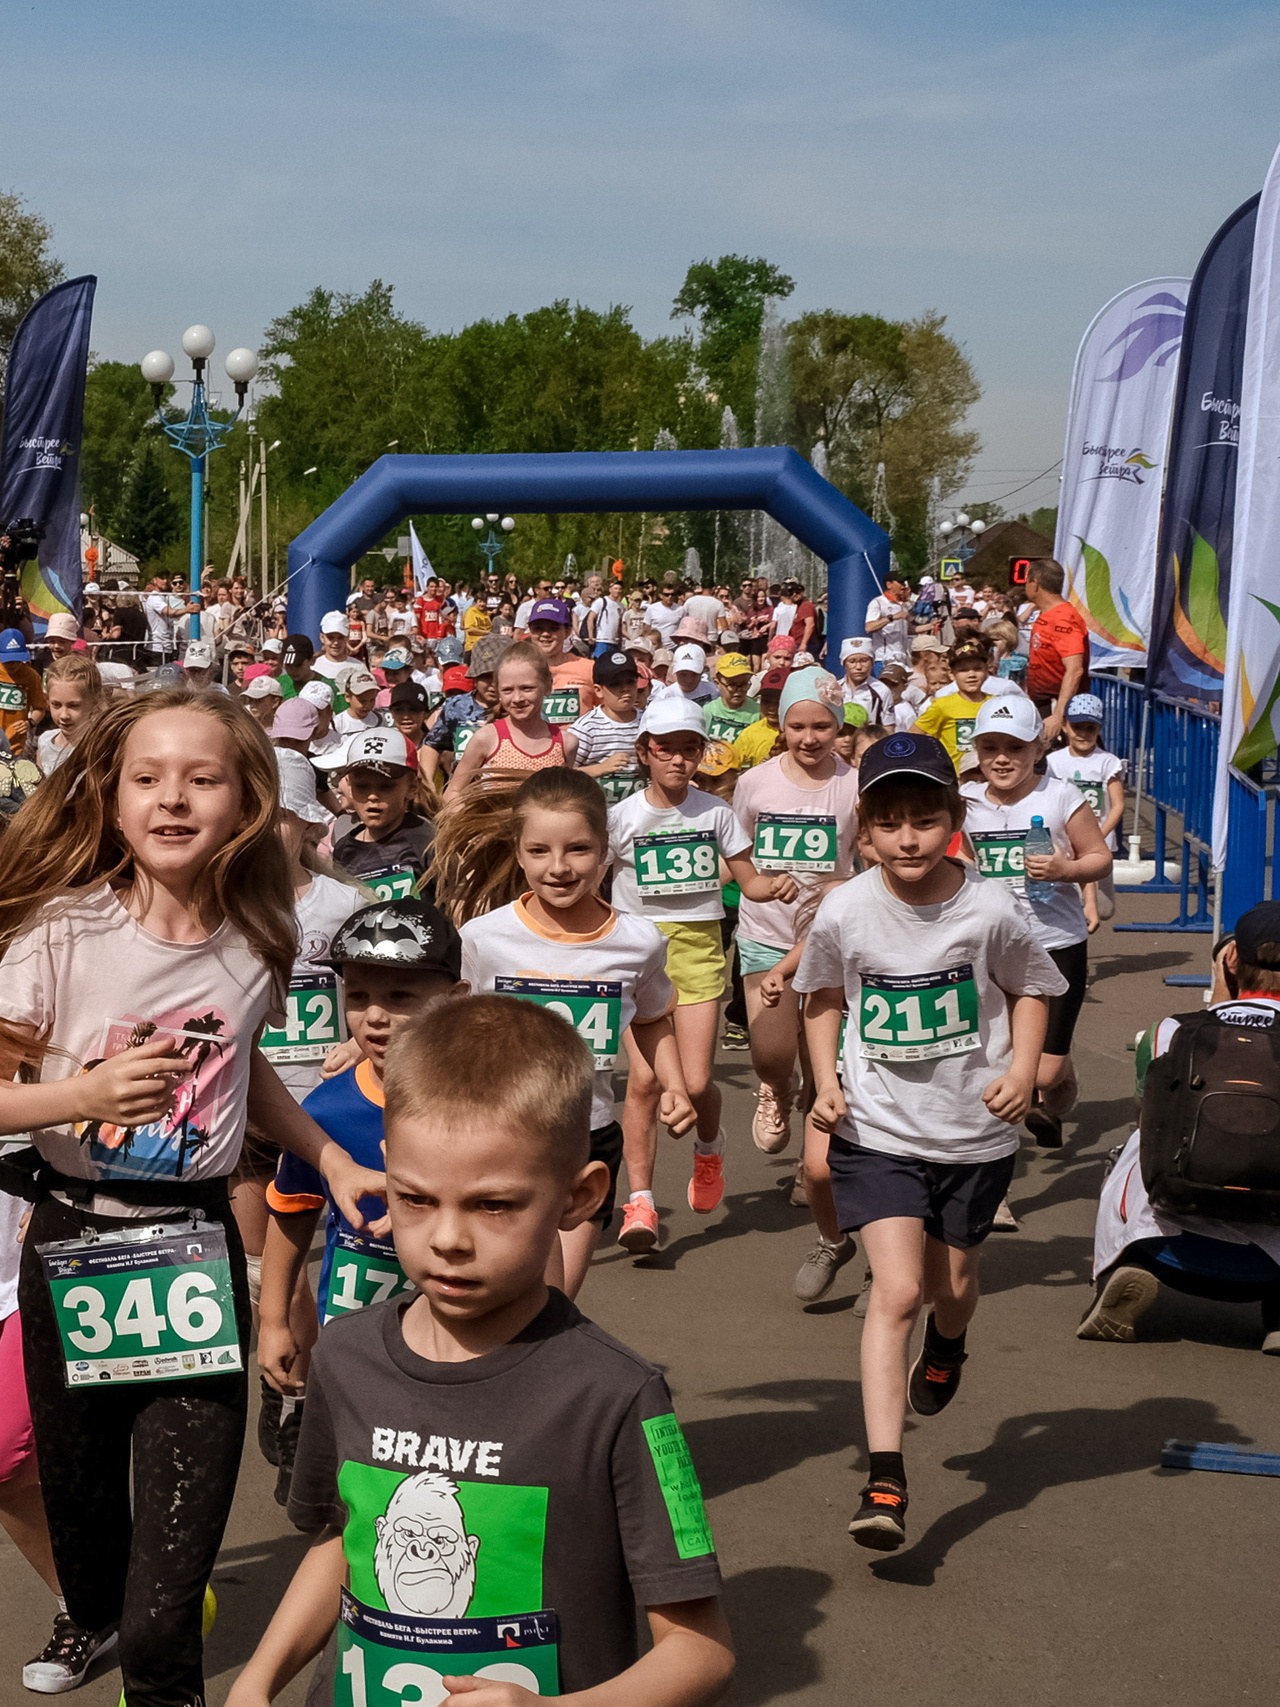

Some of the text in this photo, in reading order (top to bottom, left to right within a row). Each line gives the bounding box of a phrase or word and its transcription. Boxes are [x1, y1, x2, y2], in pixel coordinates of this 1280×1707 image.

[709, 723, 742, 743] 14
[640, 845, 716, 882] 138
[757, 826, 829, 859] 179
[268, 994, 335, 1042] 42
[863, 988, 971, 1042] 211
[62, 1270, 223, 1354] 346
[371, 1426, 504, 1477] BRAVE
